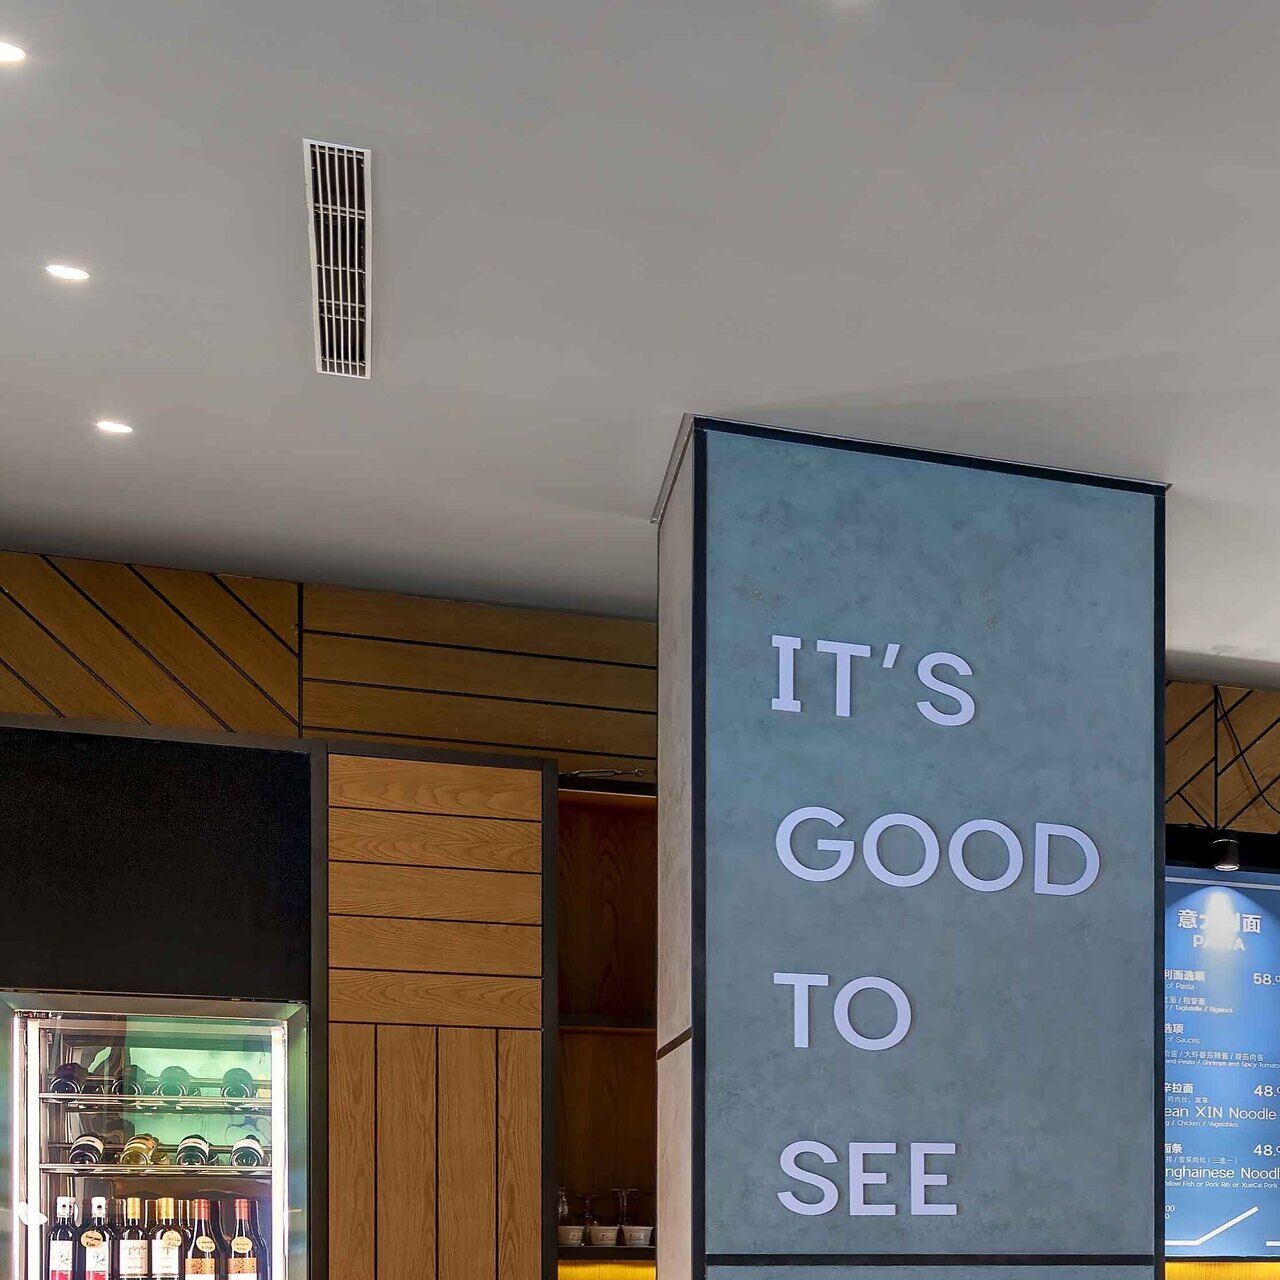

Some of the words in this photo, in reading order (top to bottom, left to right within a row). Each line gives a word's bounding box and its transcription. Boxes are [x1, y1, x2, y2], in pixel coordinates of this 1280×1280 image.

[771, 634, 977, 726] IT'S
[775, 805, 1100, 897] GOOD
[773, 972, 913, 1051] TO
[1195, 1106, 1223, 1118] XIN
[1229, 1107, 1277, 1120] Noodle
[776, 1141, 958, 1217] SEE
